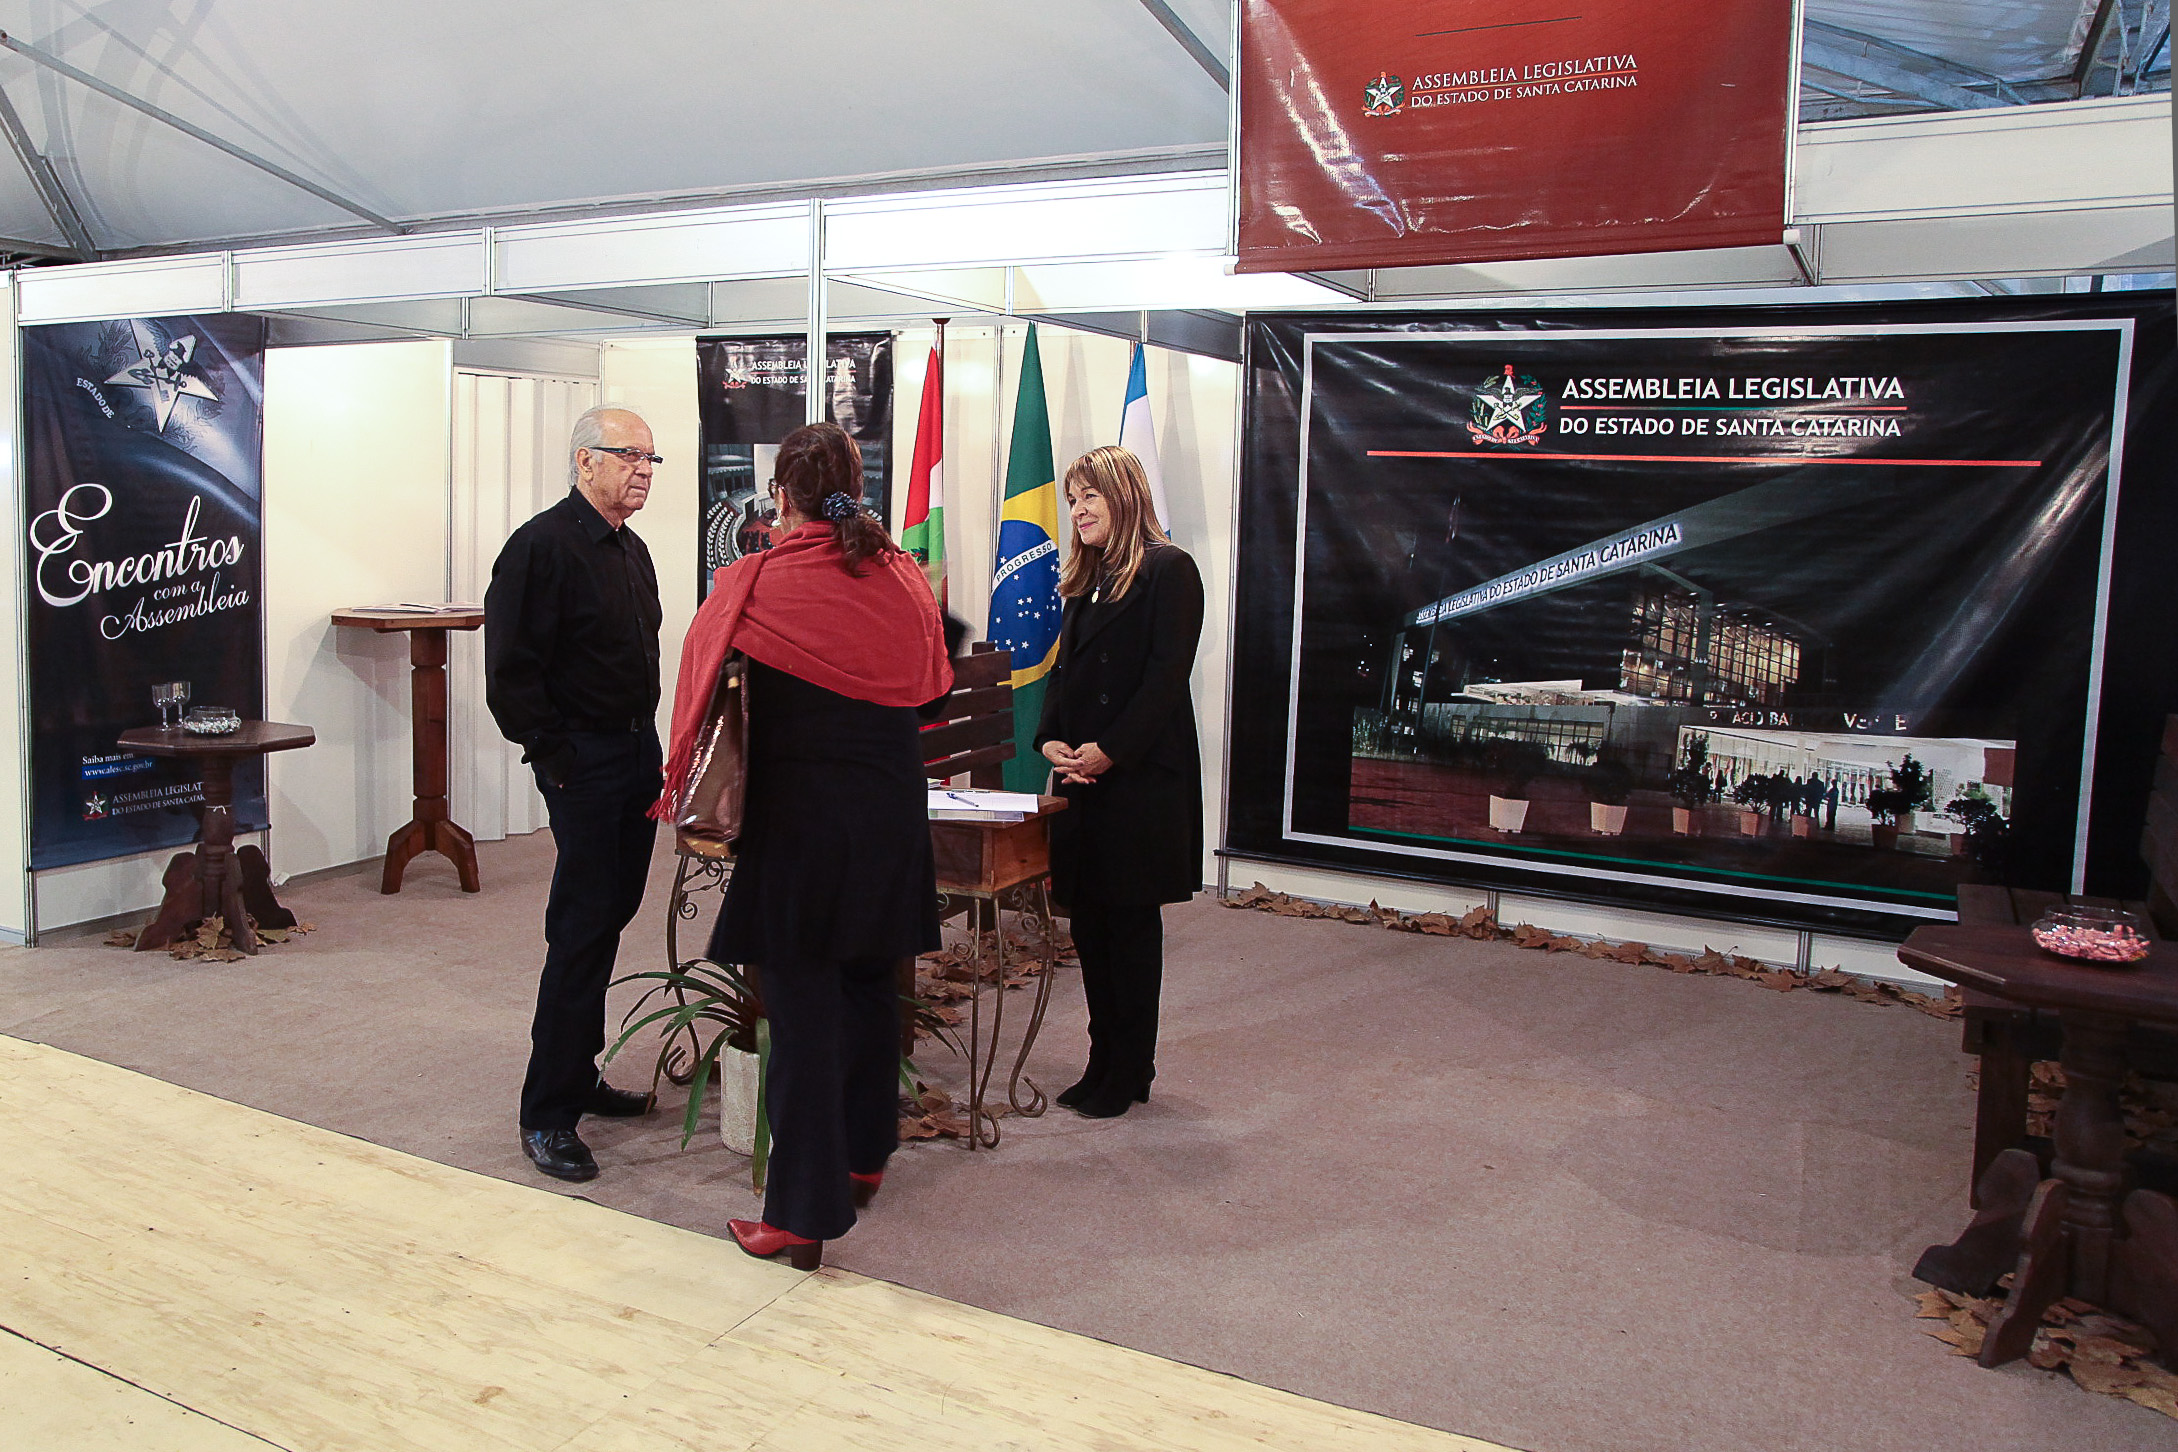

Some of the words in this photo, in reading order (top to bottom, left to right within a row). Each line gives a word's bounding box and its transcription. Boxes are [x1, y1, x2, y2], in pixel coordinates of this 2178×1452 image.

[1412, 67, 1518, 90] ASSEMBLEIA
[1523, 54, 1638, 80] LEGISLATIVA
[1411, 95, 1433, 108] DO
[1437, 89, 1490, 105] ESTADO
[1494, 87, 1512, 100] DE
[1516, 82, 1561, 99] SANTA
[1564, 75, 1638, 93] CATARINA
[751, 359, 802, 370] ASSEMBLEIA
[804, 358, 857, 369] LLATIVA
[751, 376, 761, 384] DO
[763, 375, 788, 384] ESTADO
[790, 375, 799, 384] DE
[1562, 378, 1721, 400] ASSEMBLEIA
[1729, 377, 1905, 399] LEGISLATIVA
[76, 377, 107, 407] ESTADO
[101, 404, 115, 419] DE
[1559, 417, 1589, 435] DO
[1595, 417, 1674, 436] ESTADO
[1681, 418, 1710, 436] DE
[1716, 418, 1786, 436] SANTA
[1791, 418, 1902, 437] CATARINA
[30, 483, 245, 607] Encontros
[996, 542, 1052, 582] PROGRESSO
[1490, 583, 1502, 598] DO
[1503, 572, 1538, 595] ESTADO
[1540, 565, 1555, 583] DE
[1556, 551, 1596, 578] SANTA
[1600, 523, 1678, 563] CATARINA
[154, 585, 188, 600] com
[191, 580, 202, 593] a
[101, 571, 249, 640] Assembleia
[82, 754, 104, 765] Saiba
[105, 752, 122, 762] mais
[112, 785, 163, 804] ASSEMBLEIA
[165, 781, 204, 796] LEGISLAT
[112, 807, 124, 816] DO
[125, 802, 151, 814] ESTADO
[152, 800, 161, 810] DE
[162, 796, 184, 807] SANTA
